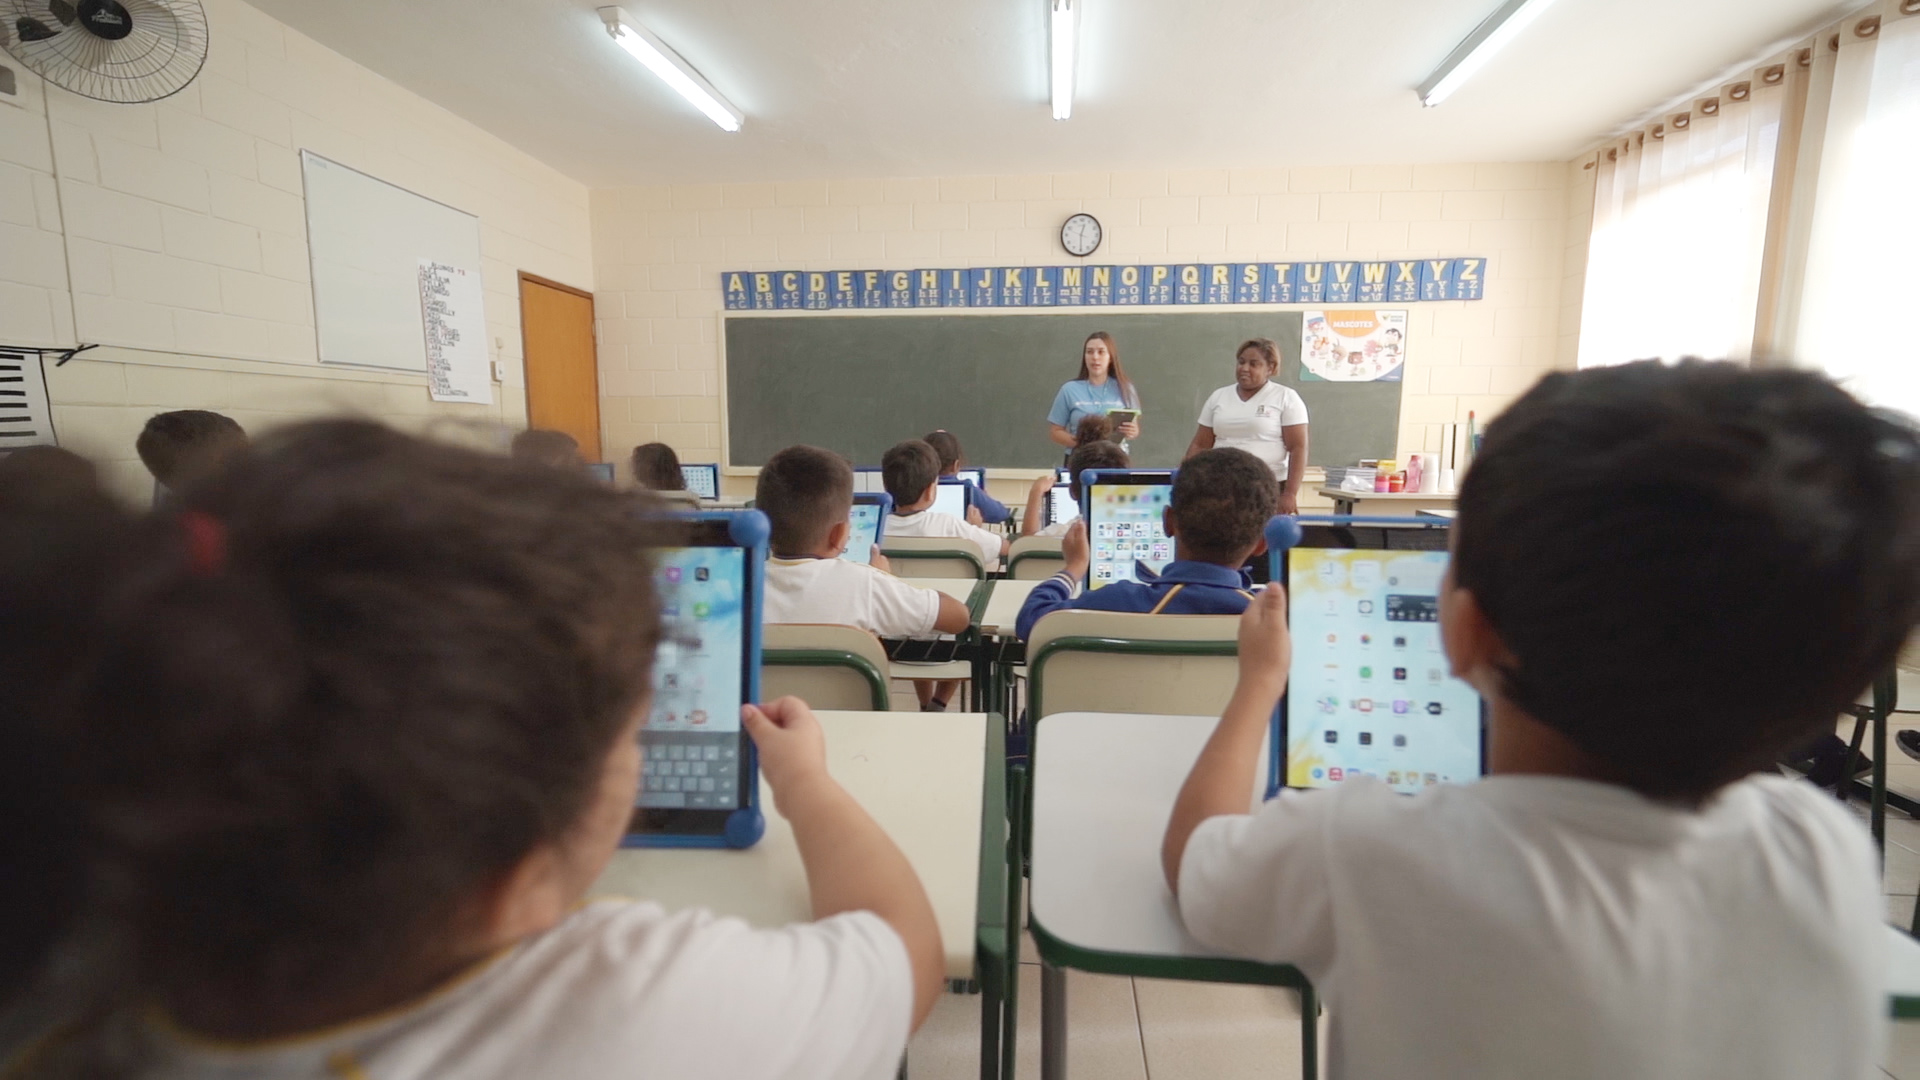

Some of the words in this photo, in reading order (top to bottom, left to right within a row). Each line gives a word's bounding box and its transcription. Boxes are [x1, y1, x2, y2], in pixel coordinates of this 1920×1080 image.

[728, 273, 744, 292] A
[755, 273, 770, 292] B
[783, 273, 797, 291] C
[810, 273, 824, 292] D
[837, 272, 851, 291] E
[865, 272, 877, 290] F
[893, 272, 908, 290] G
[921, 271, 936, 289] H
[953, 271, 959, 289] I
[978, 269, 991, 288] J
[1005, 269, 1021, 287] K
[1036, 268, 1049, 287] L
[1063, 268, 1081, 286] M
[1093, 267, 1109, 286] N
[1121, 267, 1137, 285] O
[1153, 266, 1167, 285] P
[1182, 266, 1199, 285] Q
[1212, 266, 1229, 285] R
[1243, 265, 1258, 284] S
[1274, 264, 1290, 284] T
[1305, 264, 1322, 283] U
[1334, 263, 1352, 283] V
[1364, 263, 1386, 283] W
[1396, 262, 1415, 282] X
[1430, 261, 1447, 280] Y
[1460, 260, 1479, 280] Z
